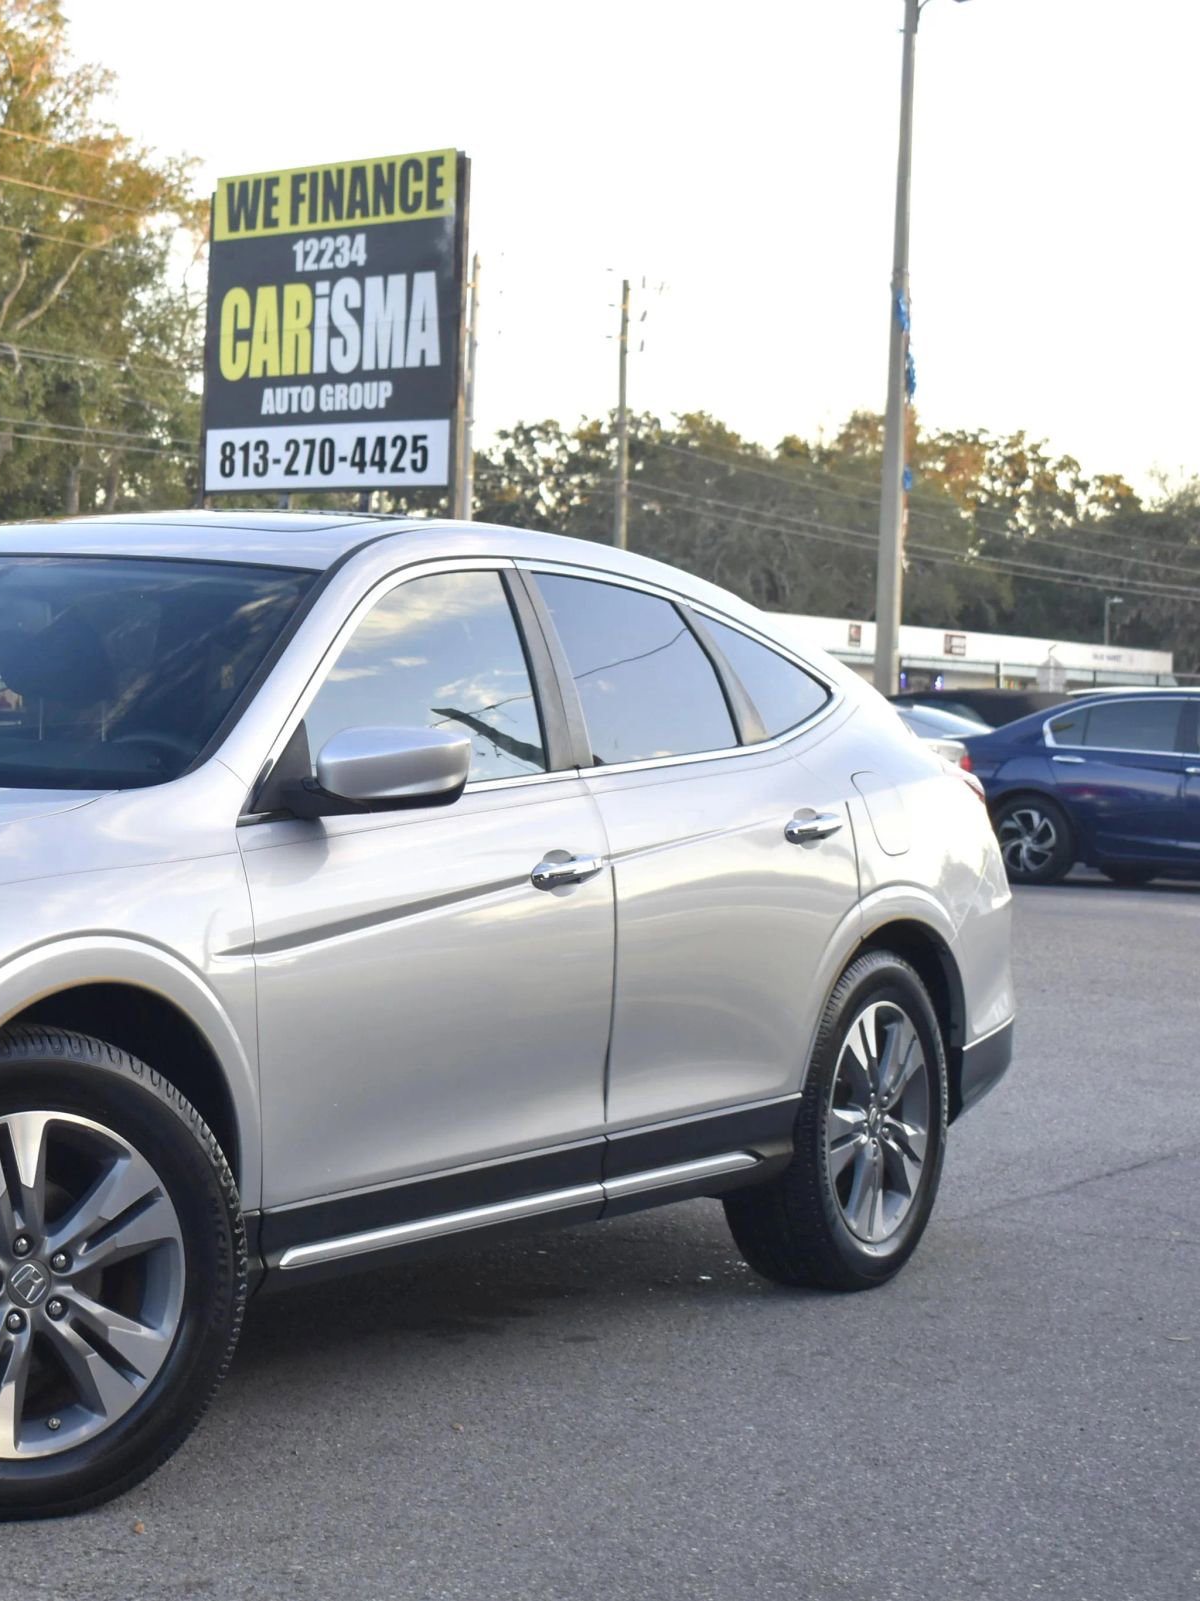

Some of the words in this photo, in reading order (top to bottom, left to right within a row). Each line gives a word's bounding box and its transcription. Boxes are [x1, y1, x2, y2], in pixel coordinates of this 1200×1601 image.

[226, 176, 279, 234] WE
[290, 155, 445, 226] FINANCE
[293, 233, 367, 272] 12234
[219, 271, 441, 381] CARiSMA
[261, 385, 315, 415] AUTO
[319, 381, 393, 412] GROUP
[219, 434, 429, 479] 813-270-4425
[207, 1197, 230, 1325] MICHELIN
